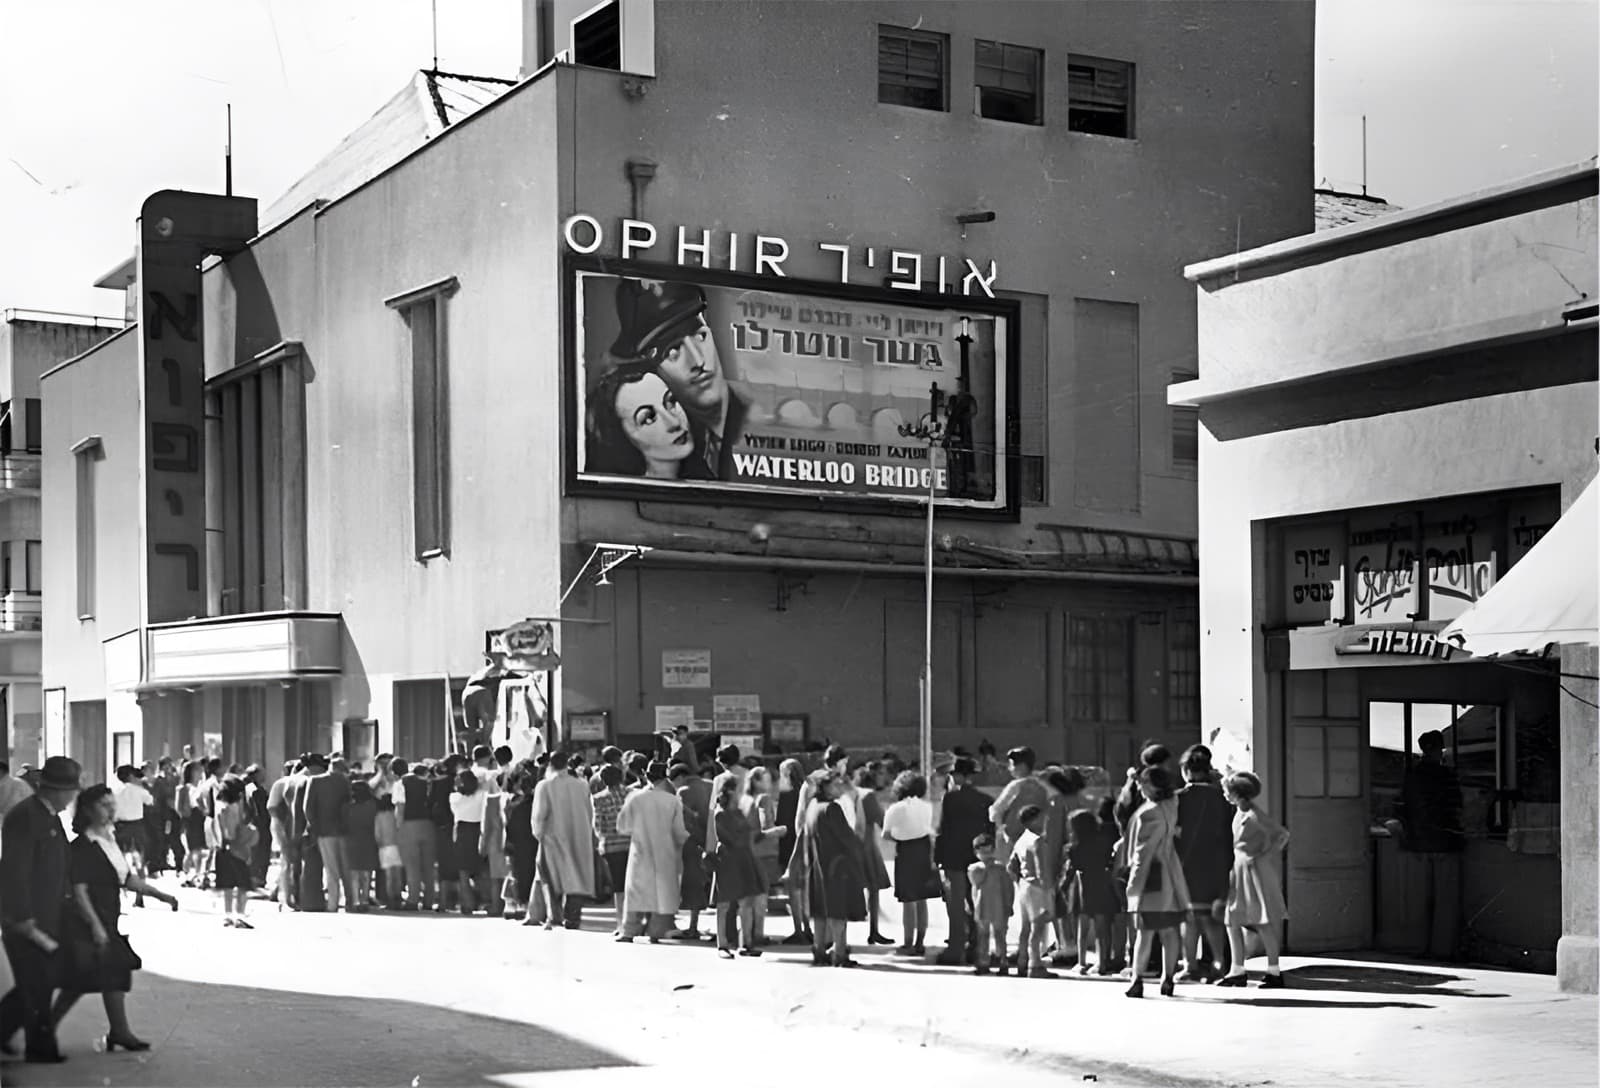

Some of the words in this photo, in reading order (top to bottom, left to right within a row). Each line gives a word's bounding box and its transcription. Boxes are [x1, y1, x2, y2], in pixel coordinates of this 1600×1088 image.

[564, 214, 790, 278] OPHIR
[819, 242, 997, 299] אופיר
[731, 319, 851, 361] ווטרלו
[863, 336, 944, 370] גשר
[149, 290, 198, 592] אופיר
[732, 453, 855, 485] WATERLOO
[865, 463, 948, 490] BRIDGE
